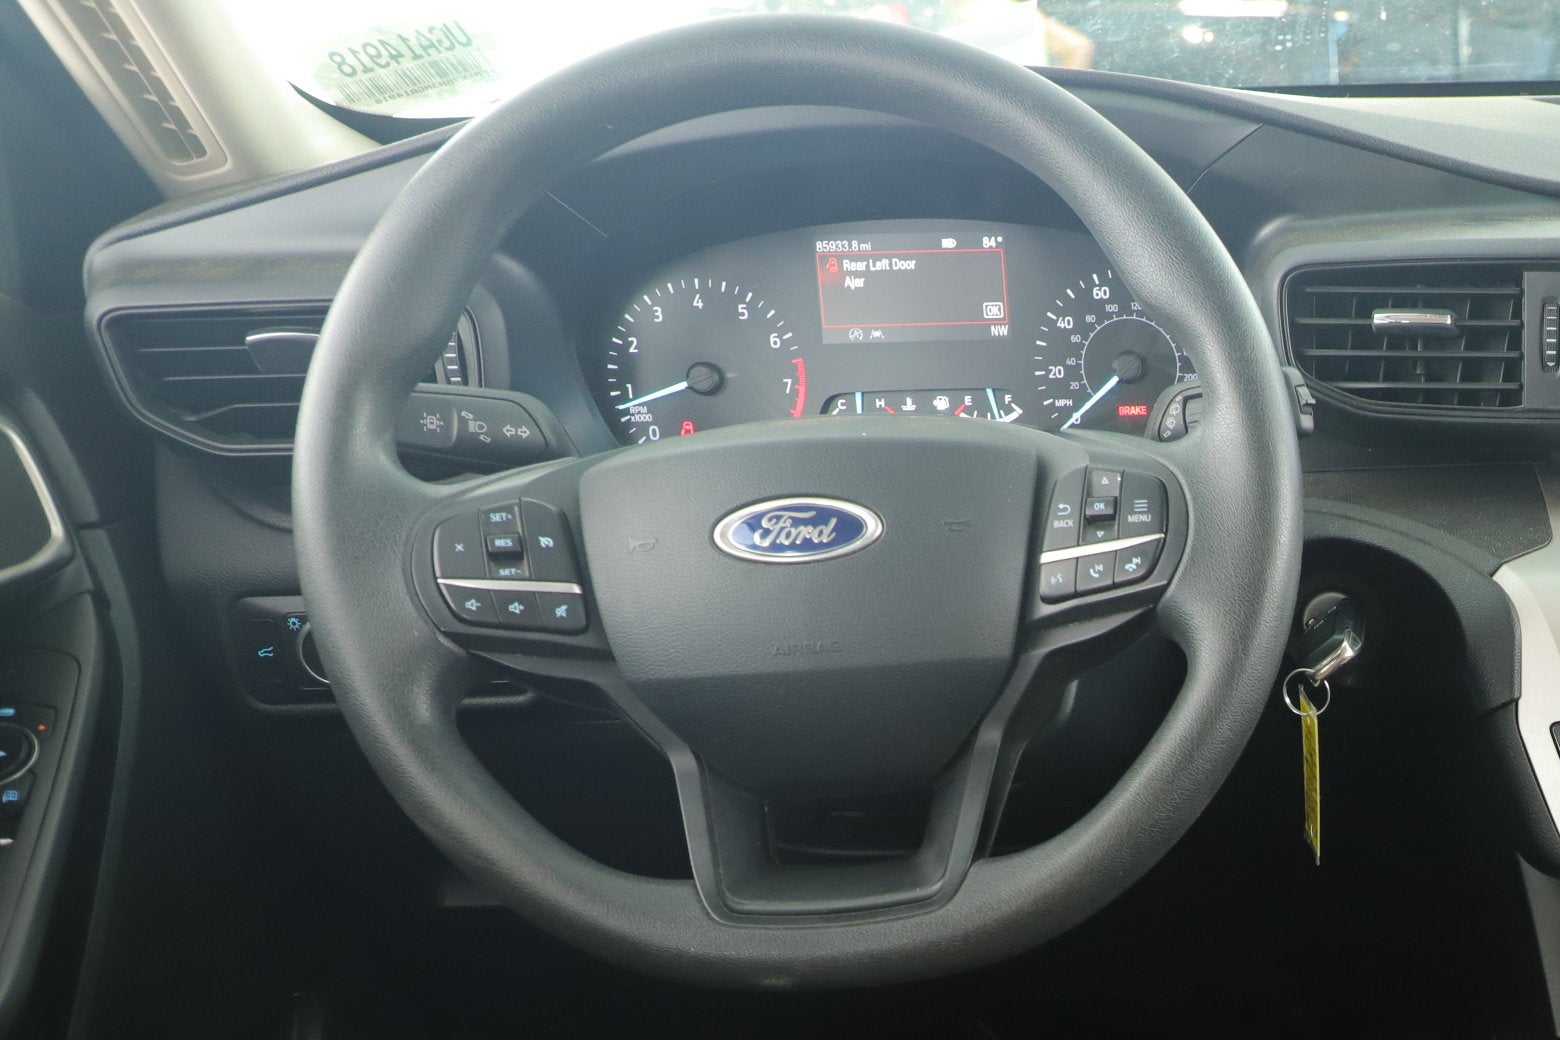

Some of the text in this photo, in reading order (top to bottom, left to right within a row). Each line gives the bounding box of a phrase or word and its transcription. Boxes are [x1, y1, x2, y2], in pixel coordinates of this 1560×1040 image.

[843, 258, 916, 271] Rear Left Door
[844, 276, 865, 289] Ajar
[1092, 286, 1110, 299] 60
[693, 294, 704, 309] 4
[738, 304, 748, 320] 5
[986, 305, 1000, 316] OK
[1105, 304, 1118, 312] 100
[652, 306, 663, 322] 3
[1085, 315, 1096, 323] 80
[1057, 316, 1073, 329] 40
[990, 325, 1009, 336] NW
[769, 333, 781, 348] 6
[1071, 335, 1081, 343] 60
[628, 337, 639, 353] 2
[1066, 358, 1076, 366] 40
[1048, 366, 1064, 378] 20
[783, 379, 792, 394] 7
[1069, 382, 1080, 390] 20
[875, 398, 885, 408] H
[964, 396, 972, 405] E
[1004, 394, 1012, 404] F
[1055, 399, 1073, 407] MPH
[629, 406, 648, 414] RPM
[837, 400, 846, 410] C
[1118, 406, 1147, 416] BRAKE
[648, 425, 660, 440] 0
[1093, 502, 1106, 511] OK
[1053, 519, 1074, 528] BACK
[1127, 514, 1151, 523] MENU
[753, 510, 837, 548] Ford
[494, 538, 513, 547] RES
